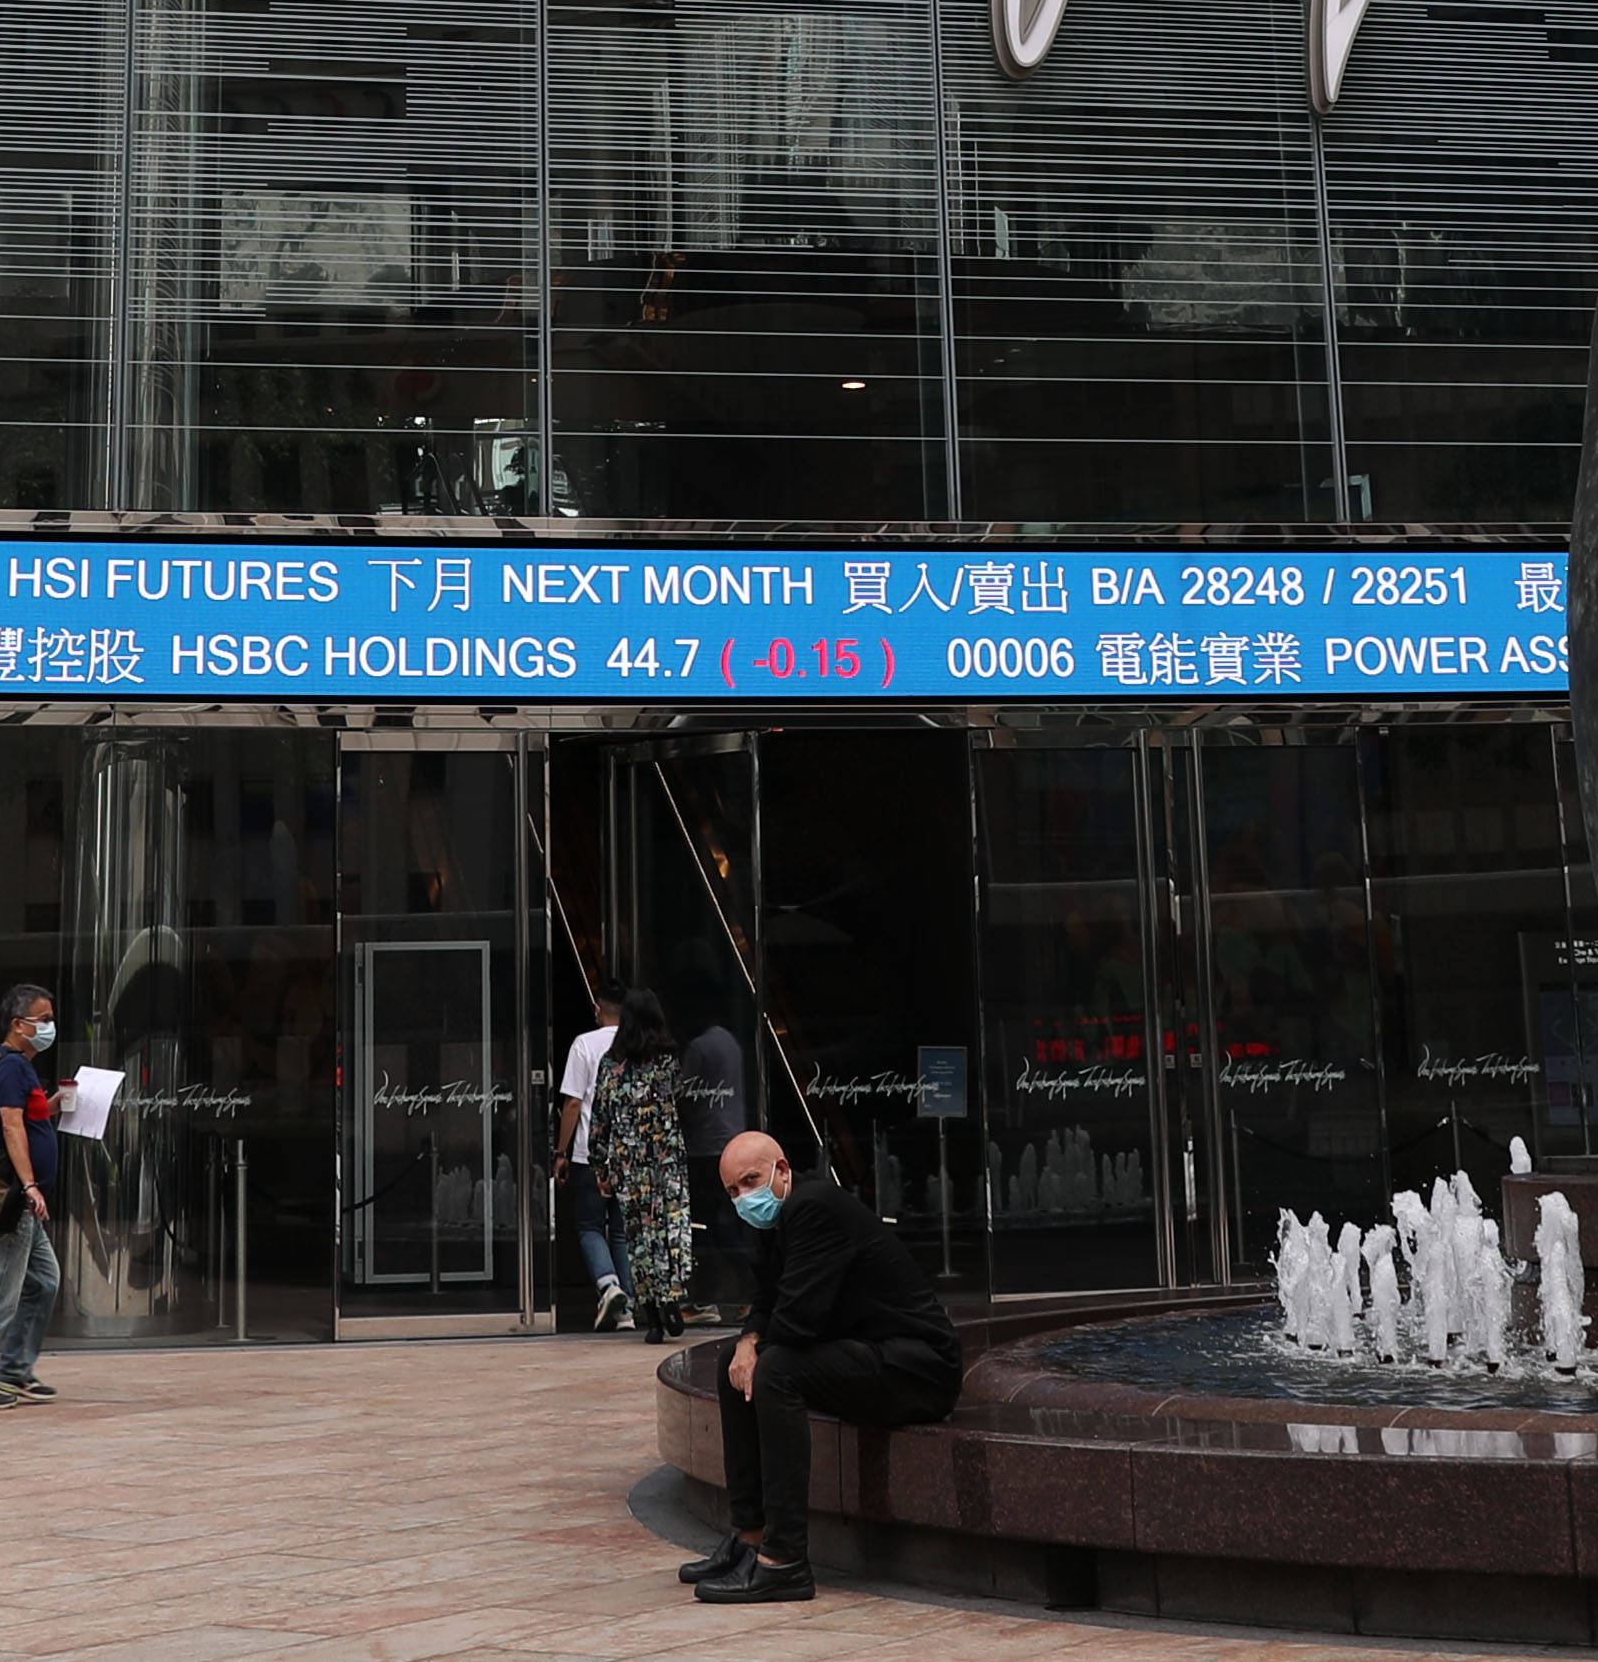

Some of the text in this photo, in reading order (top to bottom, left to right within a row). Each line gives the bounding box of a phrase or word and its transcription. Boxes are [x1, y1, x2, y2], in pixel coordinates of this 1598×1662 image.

[10, 558, 88, 598] HSI
[108, 560, 338, 602] FUTURES
[368, 558, 471, 611] 下月
[504, 565, 630, 603] NEXT
[645, 565, 812, 604] MONTH
[843, 561, 1068, 614] 買入/賣出
[1092, 568, 1165, 604] B/A
[1182, 567, 1304, 605] 28248
[1352, 567, 1466, 605] 28251
[1514, 563, 1568, 612] 最
[173, 634, 308, 676] HSBC
[326, 636, 576, 677] HOLDINGS
[607, 638, 699, 676] 44.7
[948, 638, 1074, 677] 00006
[1096, 632, 1302, 685] 電能實業
[1326, 637, 1489, 675] POWER
